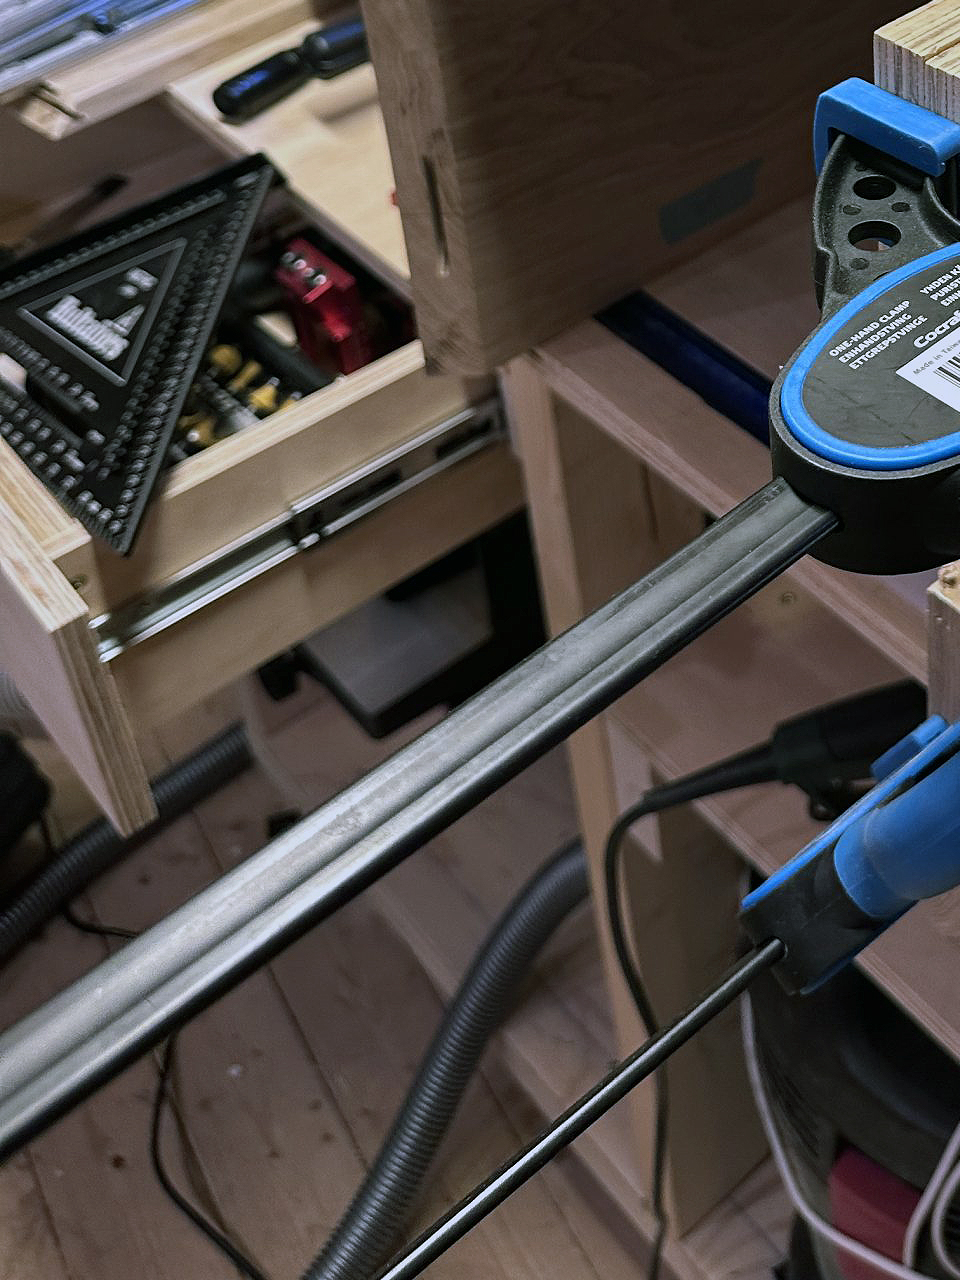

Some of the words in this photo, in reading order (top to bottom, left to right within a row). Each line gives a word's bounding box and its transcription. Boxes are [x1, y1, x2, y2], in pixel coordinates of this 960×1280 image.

[829, 321, 880, 358] ONE-HAND
[878, 300, 911, 324] CLAMP
[838, 313, 912, 364] ENHANDSTVING
[849, 315, 928, 370] ETTGREPSTVINGE
